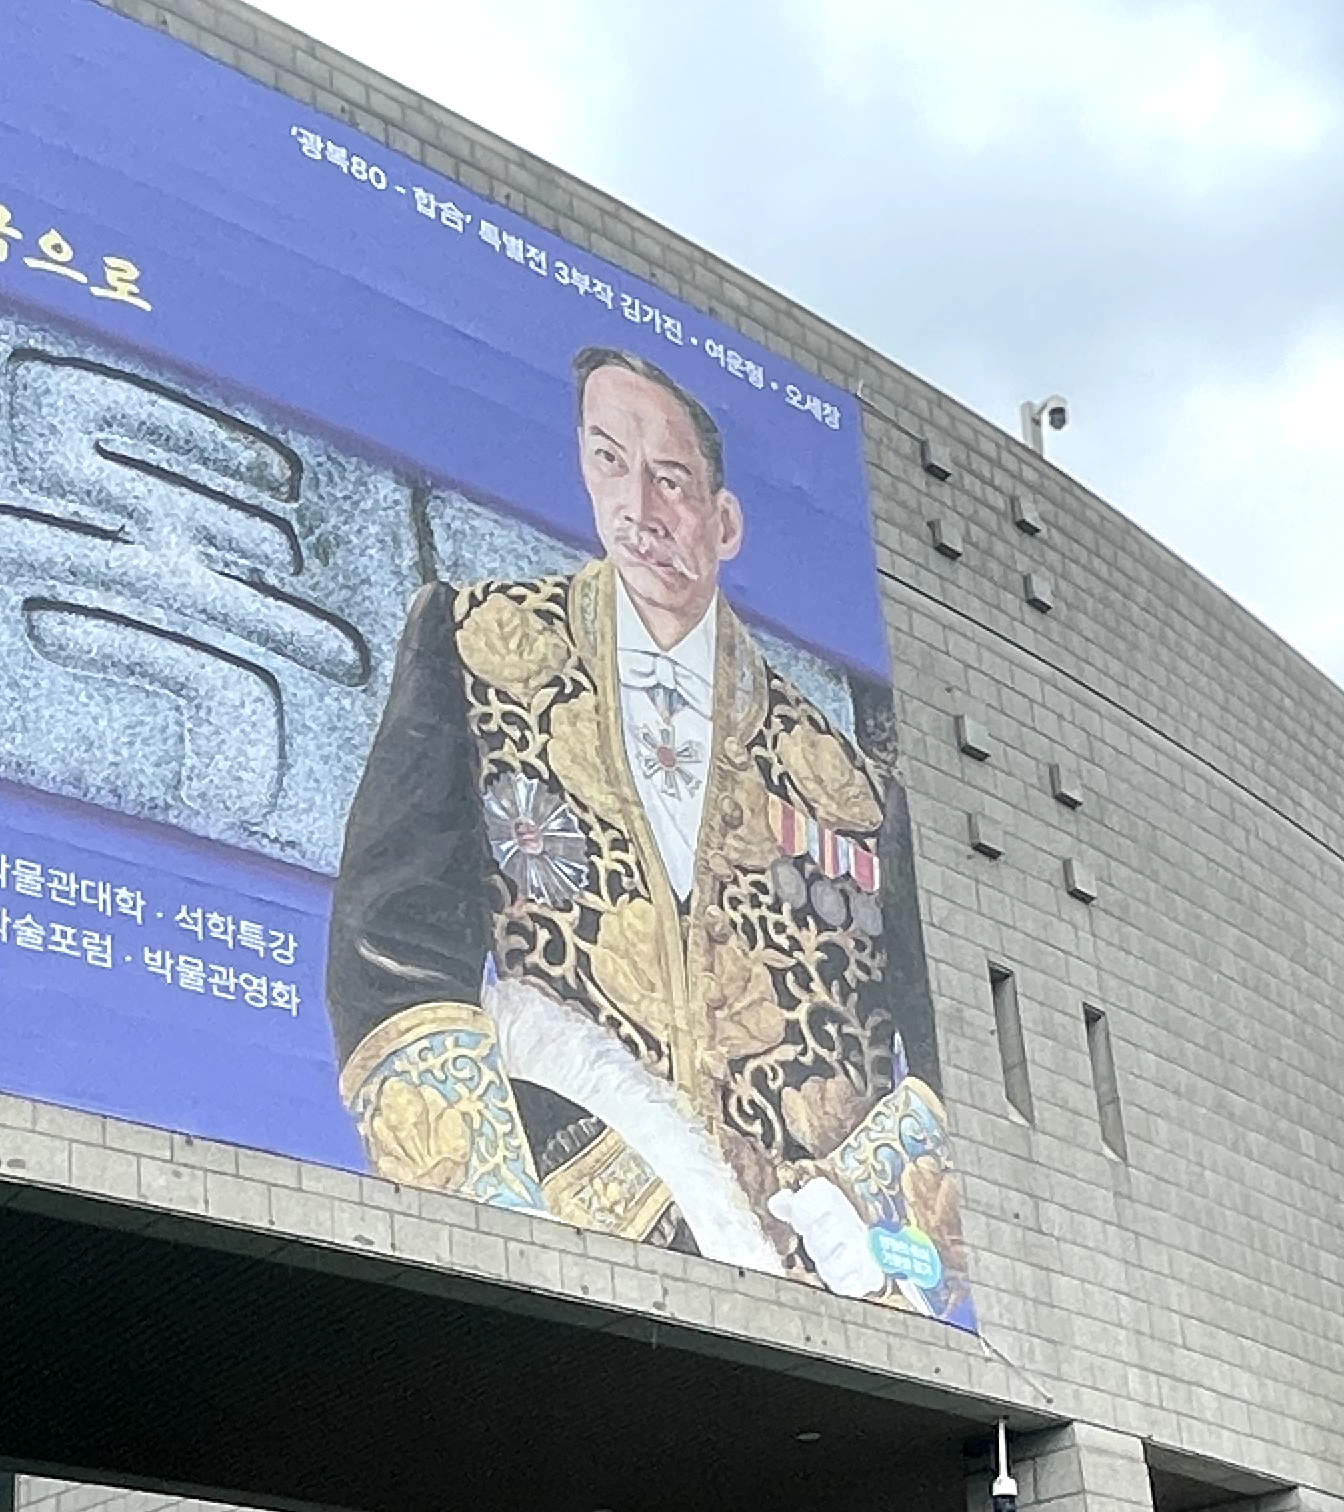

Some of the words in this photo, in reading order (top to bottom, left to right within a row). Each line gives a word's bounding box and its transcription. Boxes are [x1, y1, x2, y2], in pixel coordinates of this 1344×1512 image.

[478, 219, 548, 277] 특별전
[554, 261, 614, 310] 3부작
[619, 292, 684, 347] 김가진
[704, 338, 765, 390] 여운형
[173, 904, 299, 965] 석학특강
[143, 945, 302, 1018] 박물관영화
